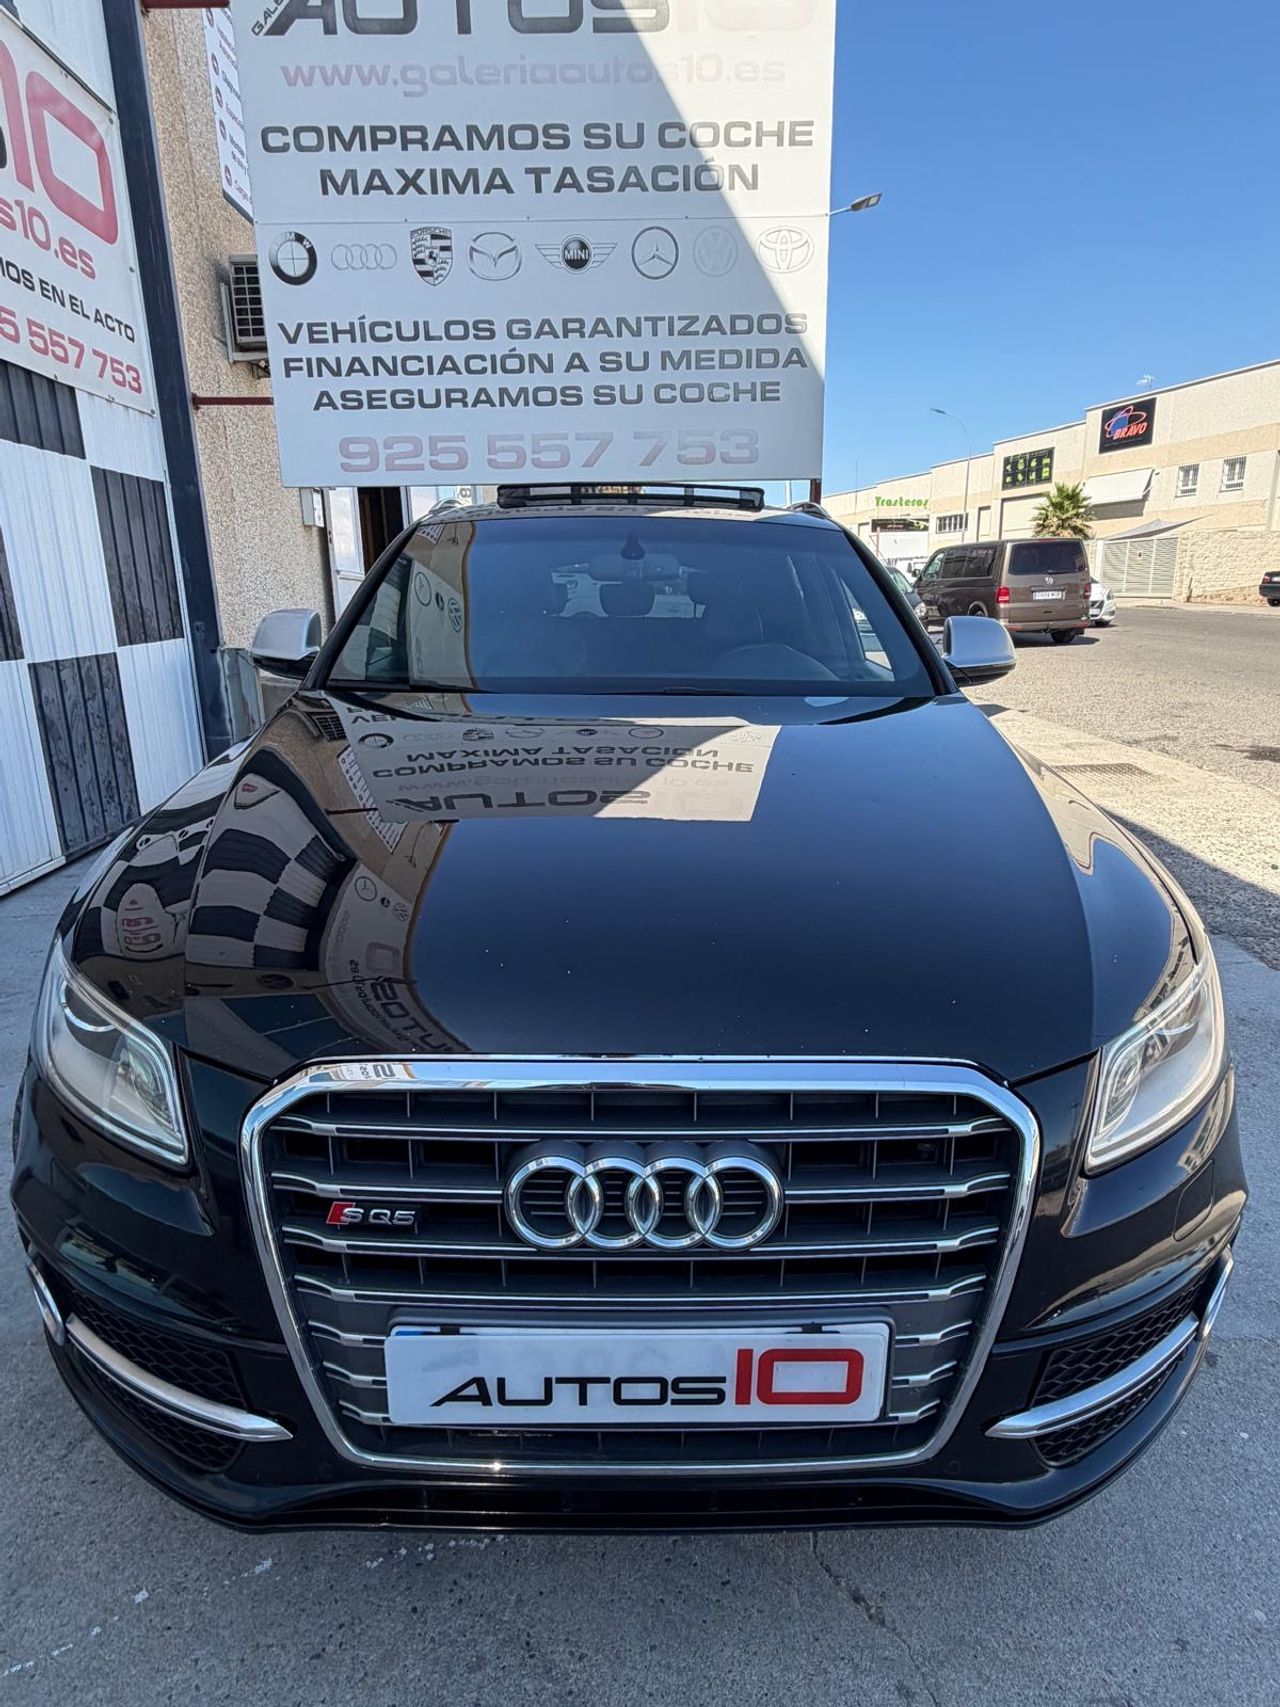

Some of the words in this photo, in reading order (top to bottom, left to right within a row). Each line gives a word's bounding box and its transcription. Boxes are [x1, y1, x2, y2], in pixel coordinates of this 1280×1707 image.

[260, 123, 570, 155] COMPRAMOS
[583, 122, 645, 151] SU
[657, 120, 814, 149] COCHE
[320, 167, 514, 197] MAXIMA
[564, 249, 589, 261] MINI
[39, 277, 66, 308] EN
[69, 293, 90, 320] EL
[94, 308, 135, 343] ACTO
[277, 315, 496, 345] VEHÍCULOS
[506, 313, 807, 340] GARANTIZADOS
[26, 317, 85, 369] 557
[92, 348, 142, 394] 753
[283, 347, 553, 379] FINANCIACIÓN
[564, 352, 590, 374] A
[600, 351, 650, 373] SU
[660, 348, 807, 371] MEDIDA
[313, 386, 583, 411] ASEGURAMOS
[593, 384, 644, 407] SU
[653, 381, 780, 404] COCHE
[1113, 422, 1147, 440] BRAVO
[339, 435, 469, 473] 925
[486, 432, 614, 470] 557
[633, 430, 760, 467] 753
